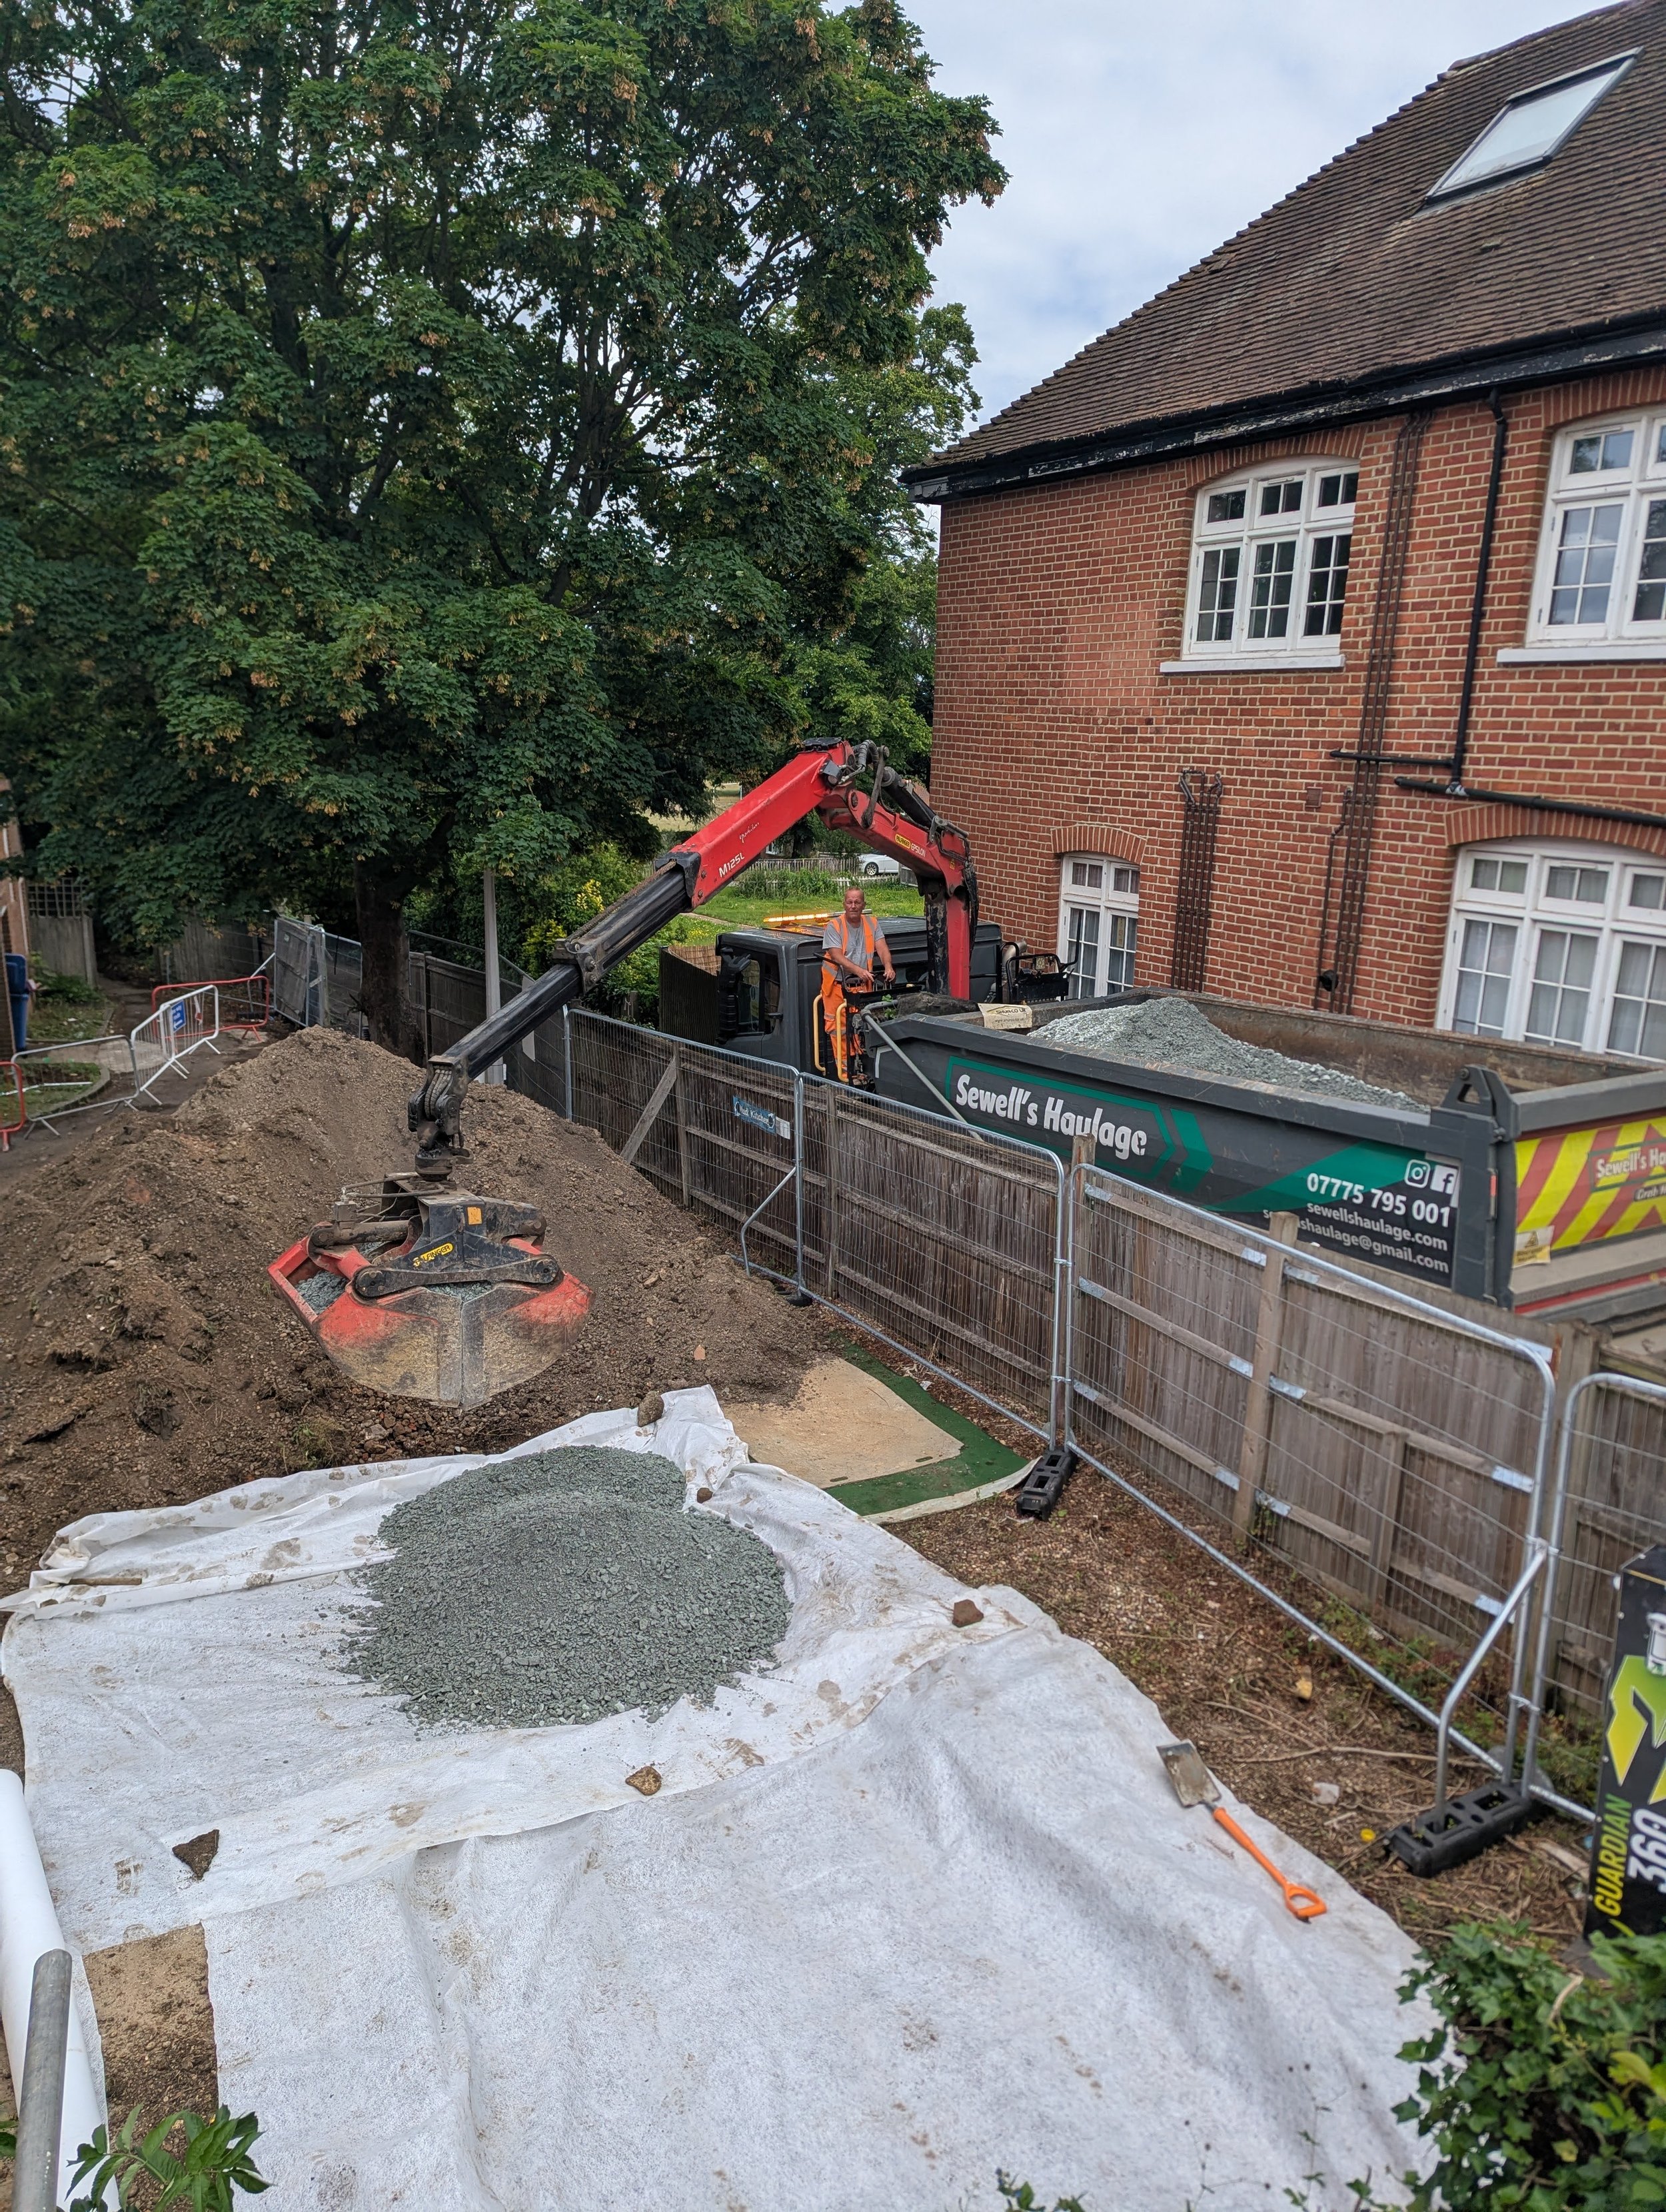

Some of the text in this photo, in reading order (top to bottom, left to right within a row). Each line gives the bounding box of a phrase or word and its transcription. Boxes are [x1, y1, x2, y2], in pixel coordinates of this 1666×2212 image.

[719, 853, 745, 877] M125L
[956, 1074, 1147, 1160] Sewell's Haulage
[1595, 1151, 1647, 1179] Sewell's
[1307, 1173, 1450, 1227] 07775 795 001
[1307, 1203, 1448, 1251] sewellshaulage.com
[1593, 1793, 1633, 1917] GUARDIAN
[1627, 1808, 1666, 1894] 360
